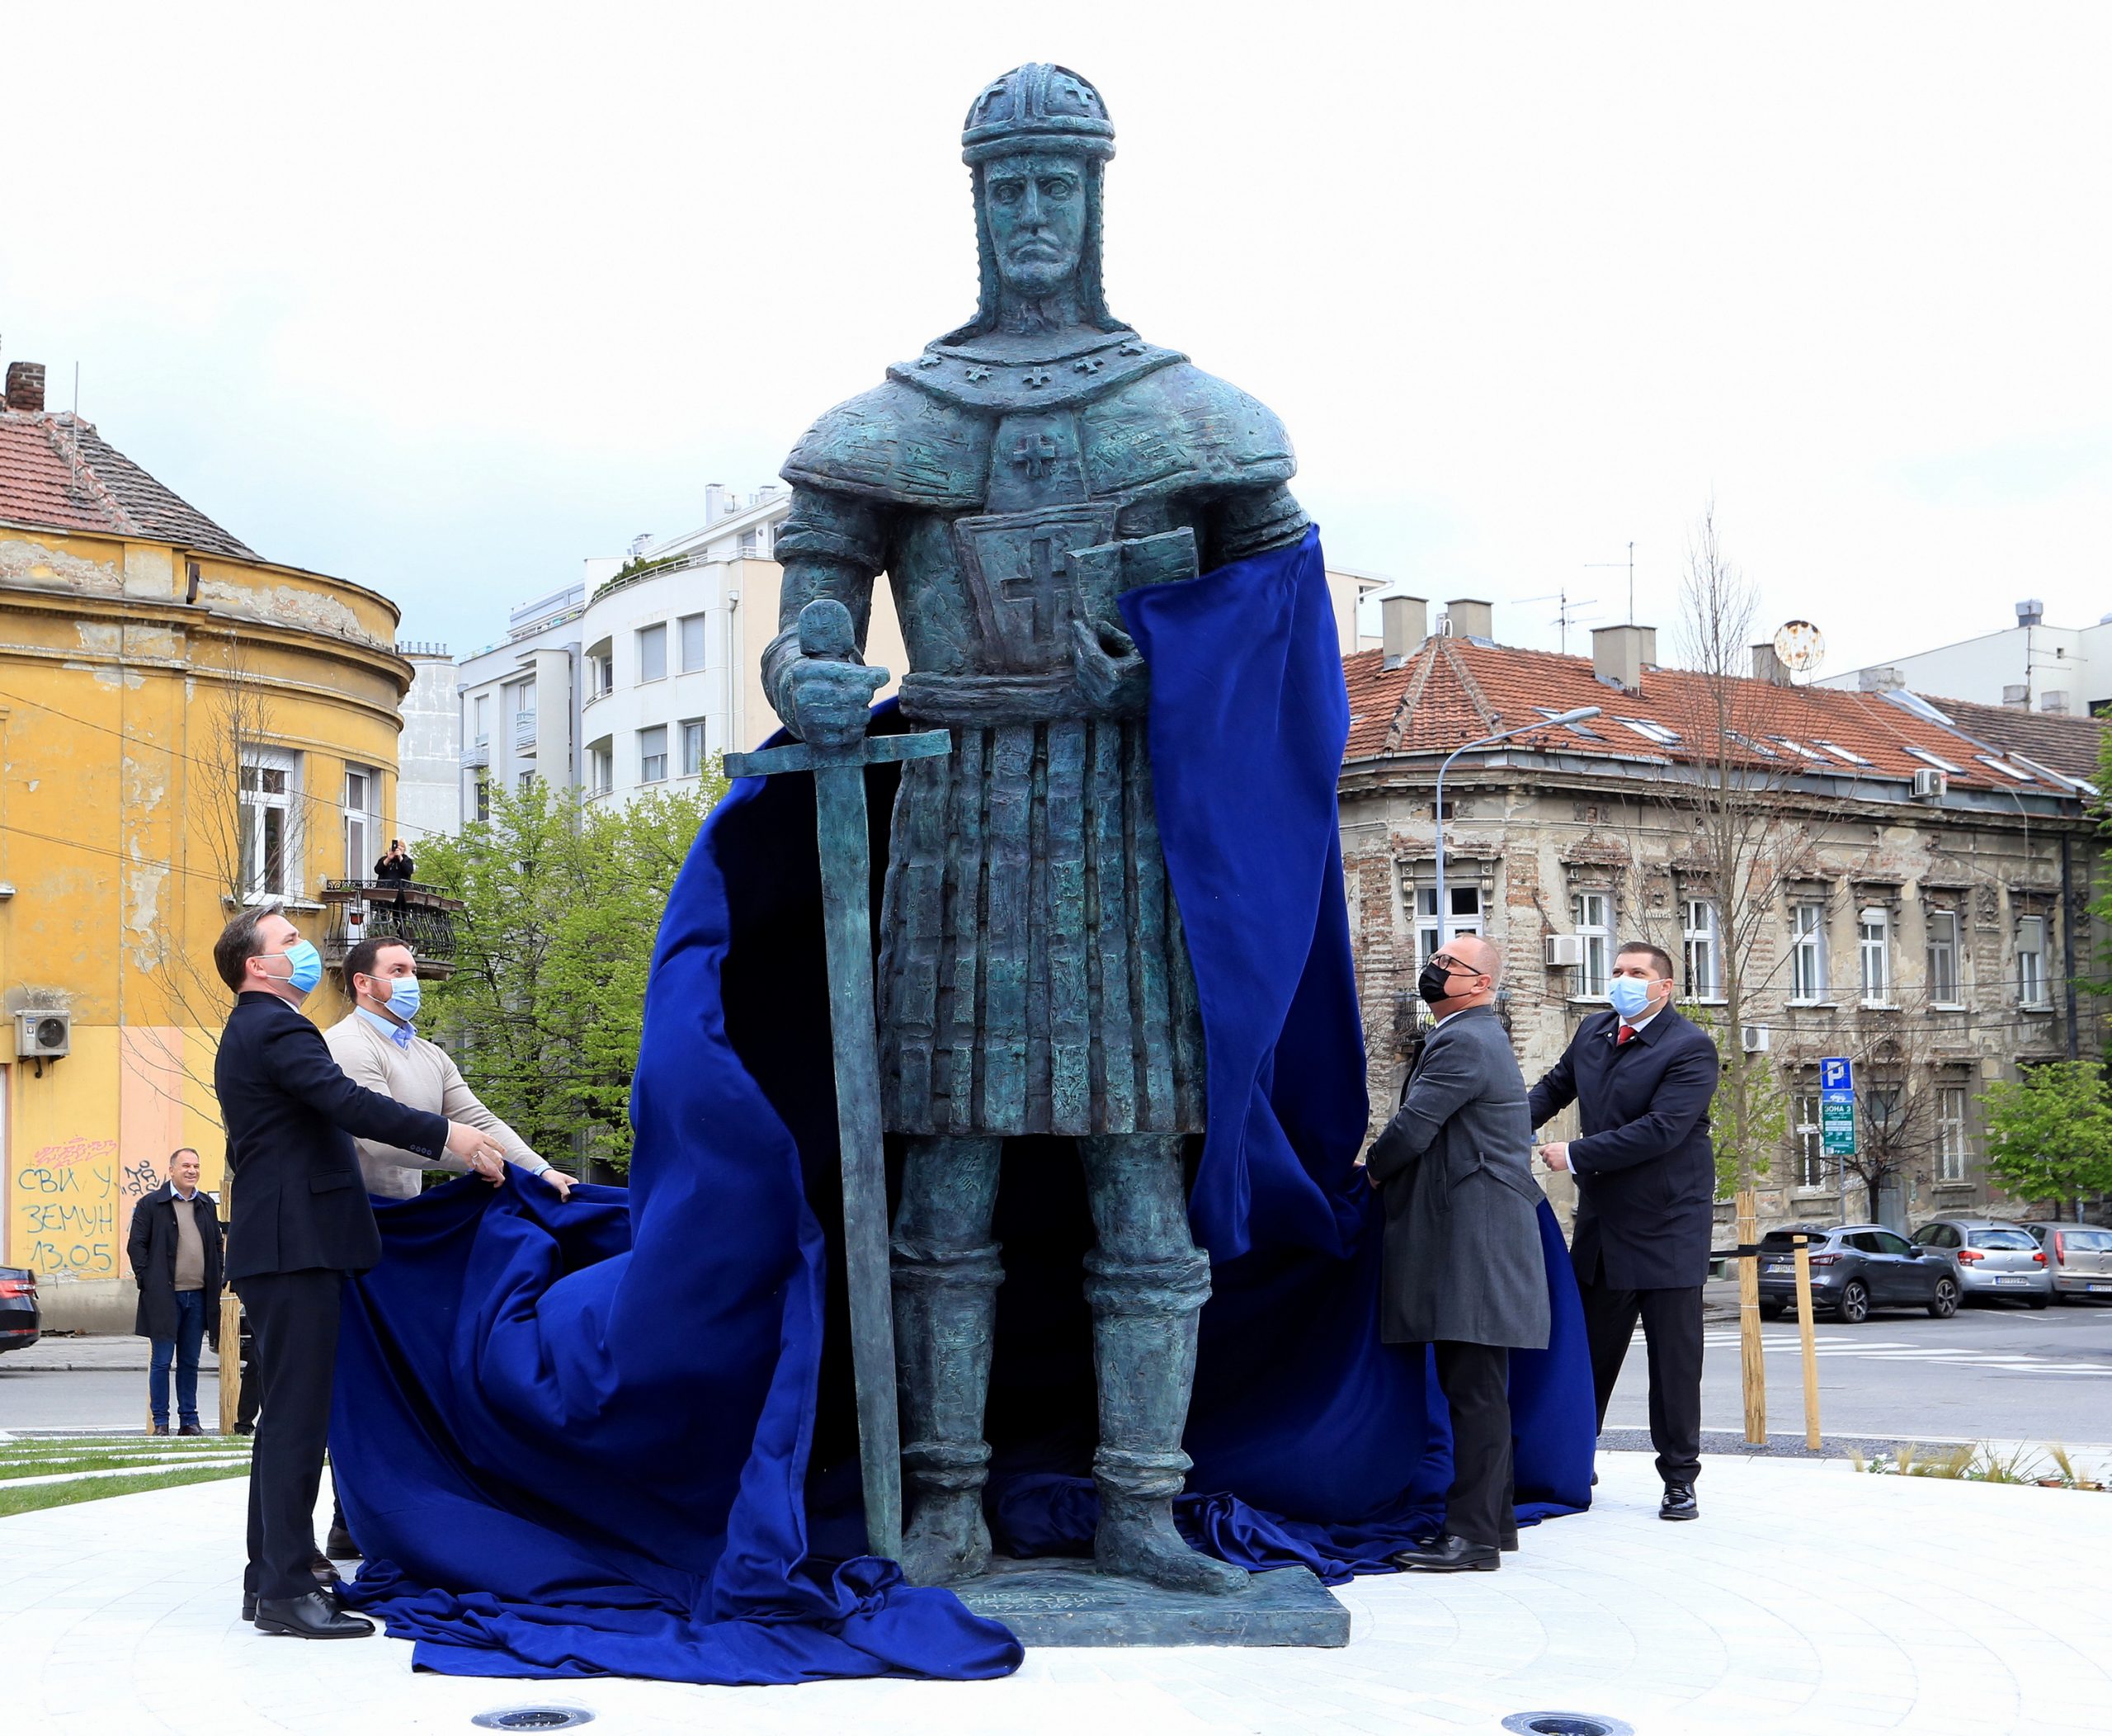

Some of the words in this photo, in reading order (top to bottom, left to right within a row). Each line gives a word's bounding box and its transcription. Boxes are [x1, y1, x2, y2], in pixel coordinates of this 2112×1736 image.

[1827, 1061, 1845, 1086] P
[18, 1168, 79, 1193] СВИ
[93, 1166, 111, 1198] У
[22, 1203, 113, 1238] ЗЕМУН
[30, 1240, 112, 1271] 13.05
